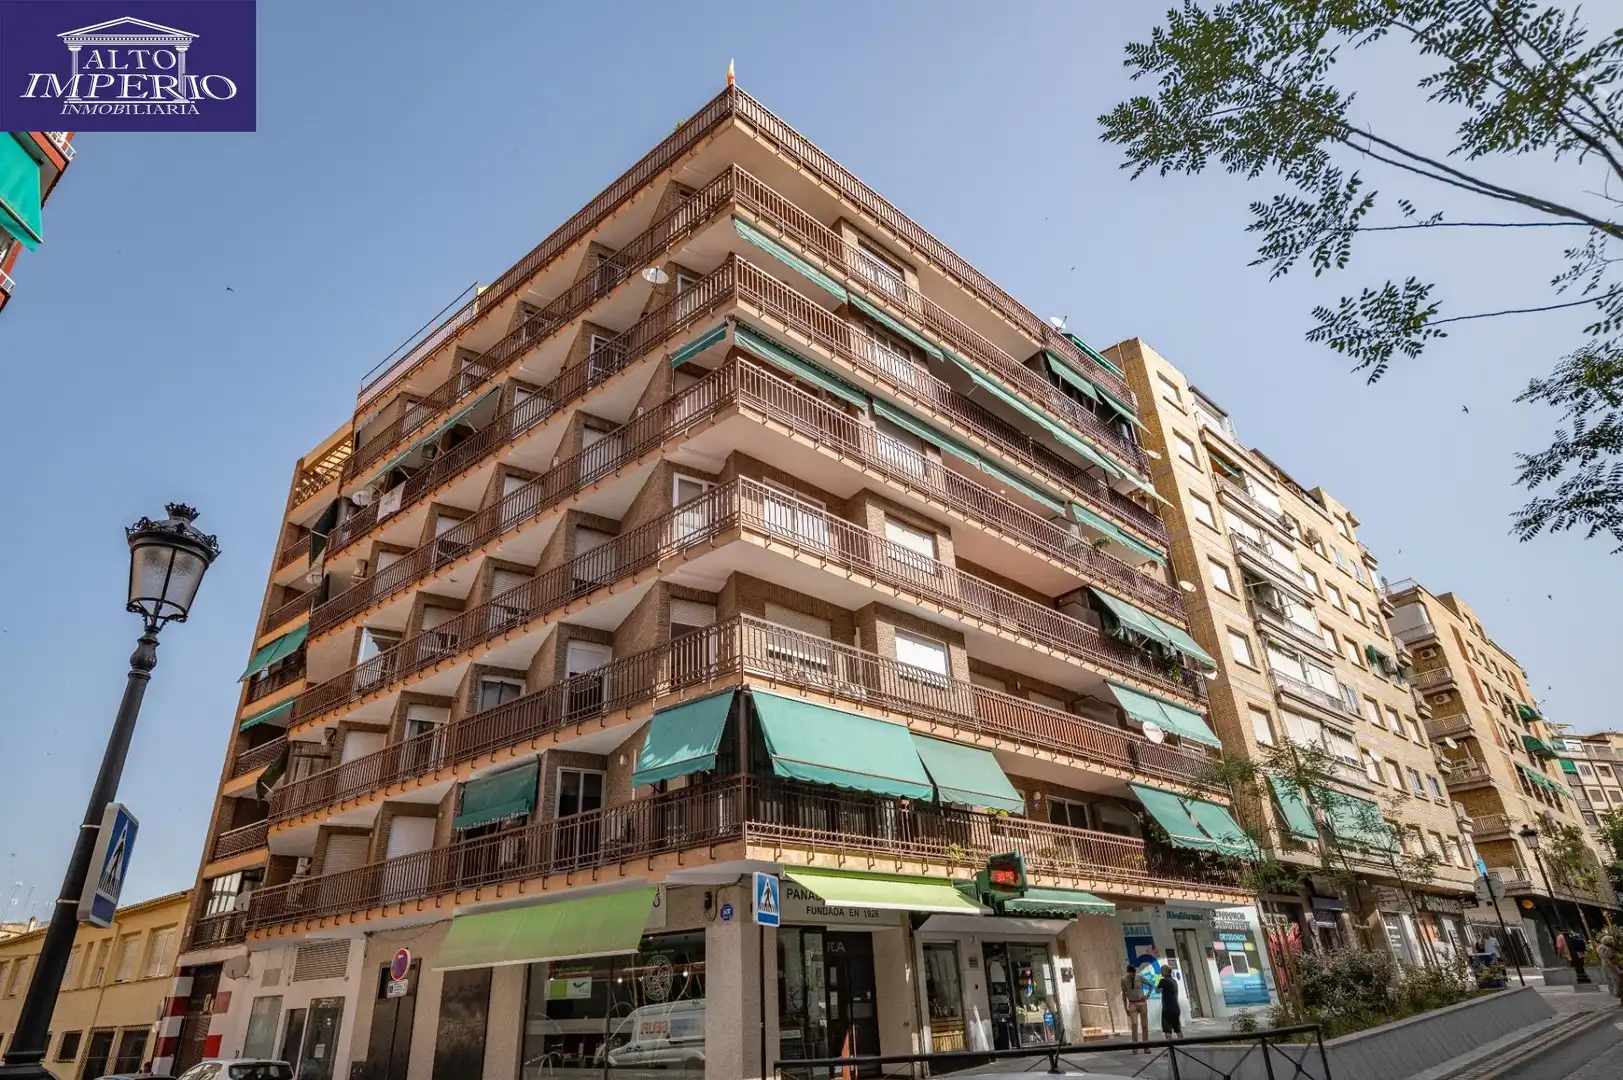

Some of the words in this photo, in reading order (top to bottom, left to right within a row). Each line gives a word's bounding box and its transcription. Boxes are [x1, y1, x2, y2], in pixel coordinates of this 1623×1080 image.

[806, 905, 845, 917] FUNDADA
[848, 908, 860, 918] EN
[863, 909, 880, 919] 1926
